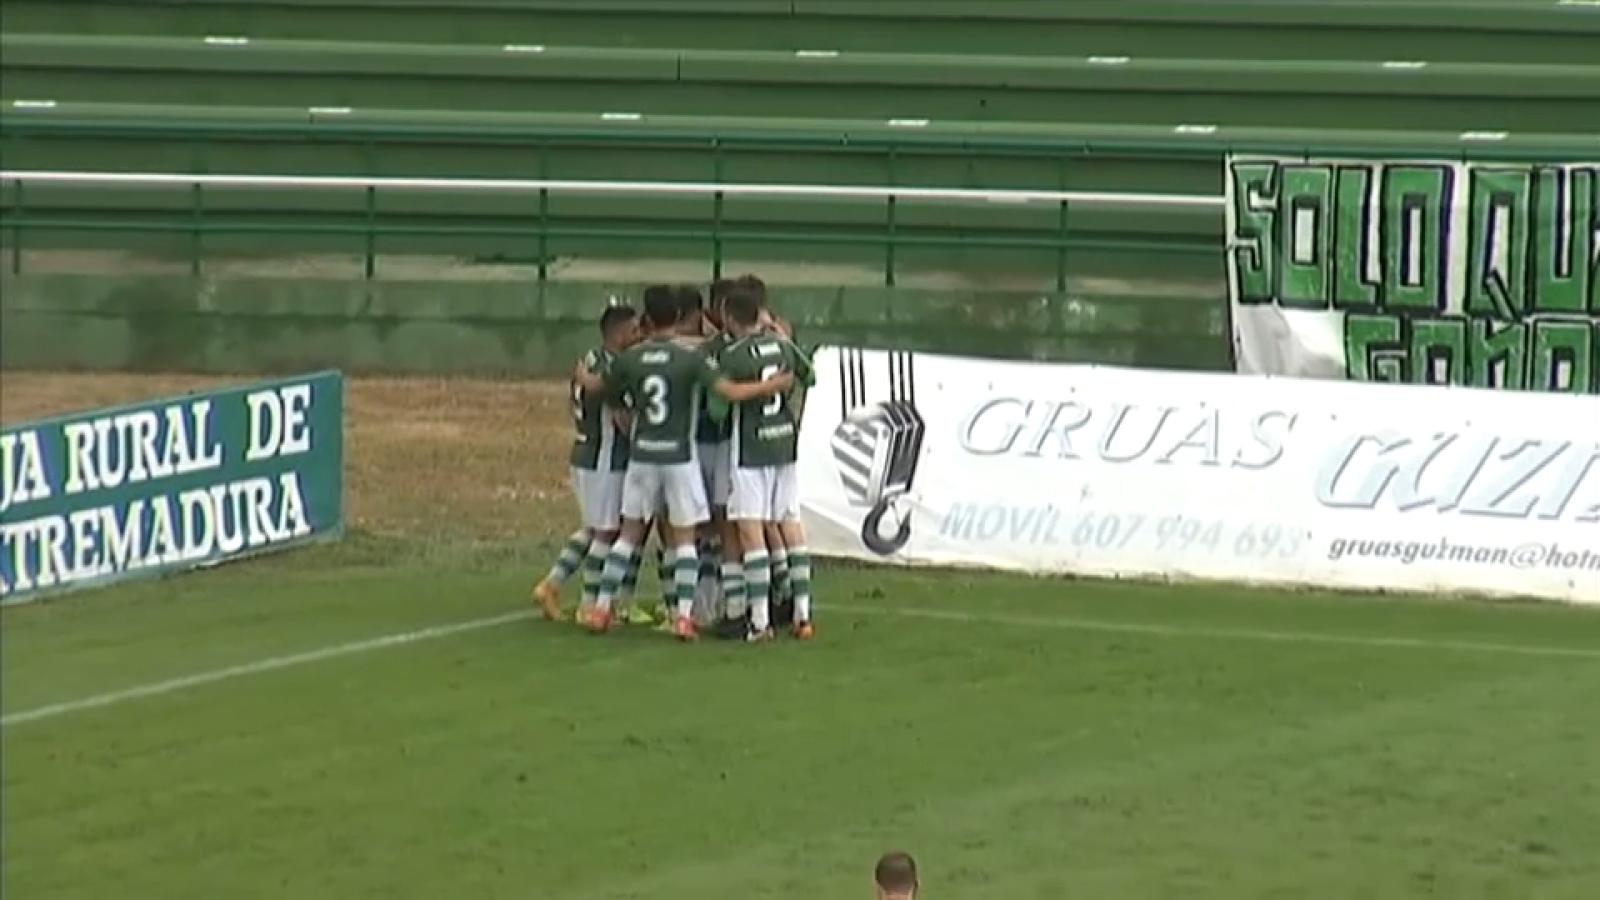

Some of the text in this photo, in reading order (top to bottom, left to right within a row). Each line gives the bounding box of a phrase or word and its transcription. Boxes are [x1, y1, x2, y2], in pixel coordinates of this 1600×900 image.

[1229, 160, 1600, 320] SOLO QU
[63, 399, 222, 494] RURAL
[246, 383, 311, 462] DE
[642, 374, 668, 425] 3
[957, 396, 1299, 471] GRUAS
[0, 470, 312, 595] TREMADURA
[1071, 510, 1146, 550] 607
[1155, 514, 1223, 552] 994
